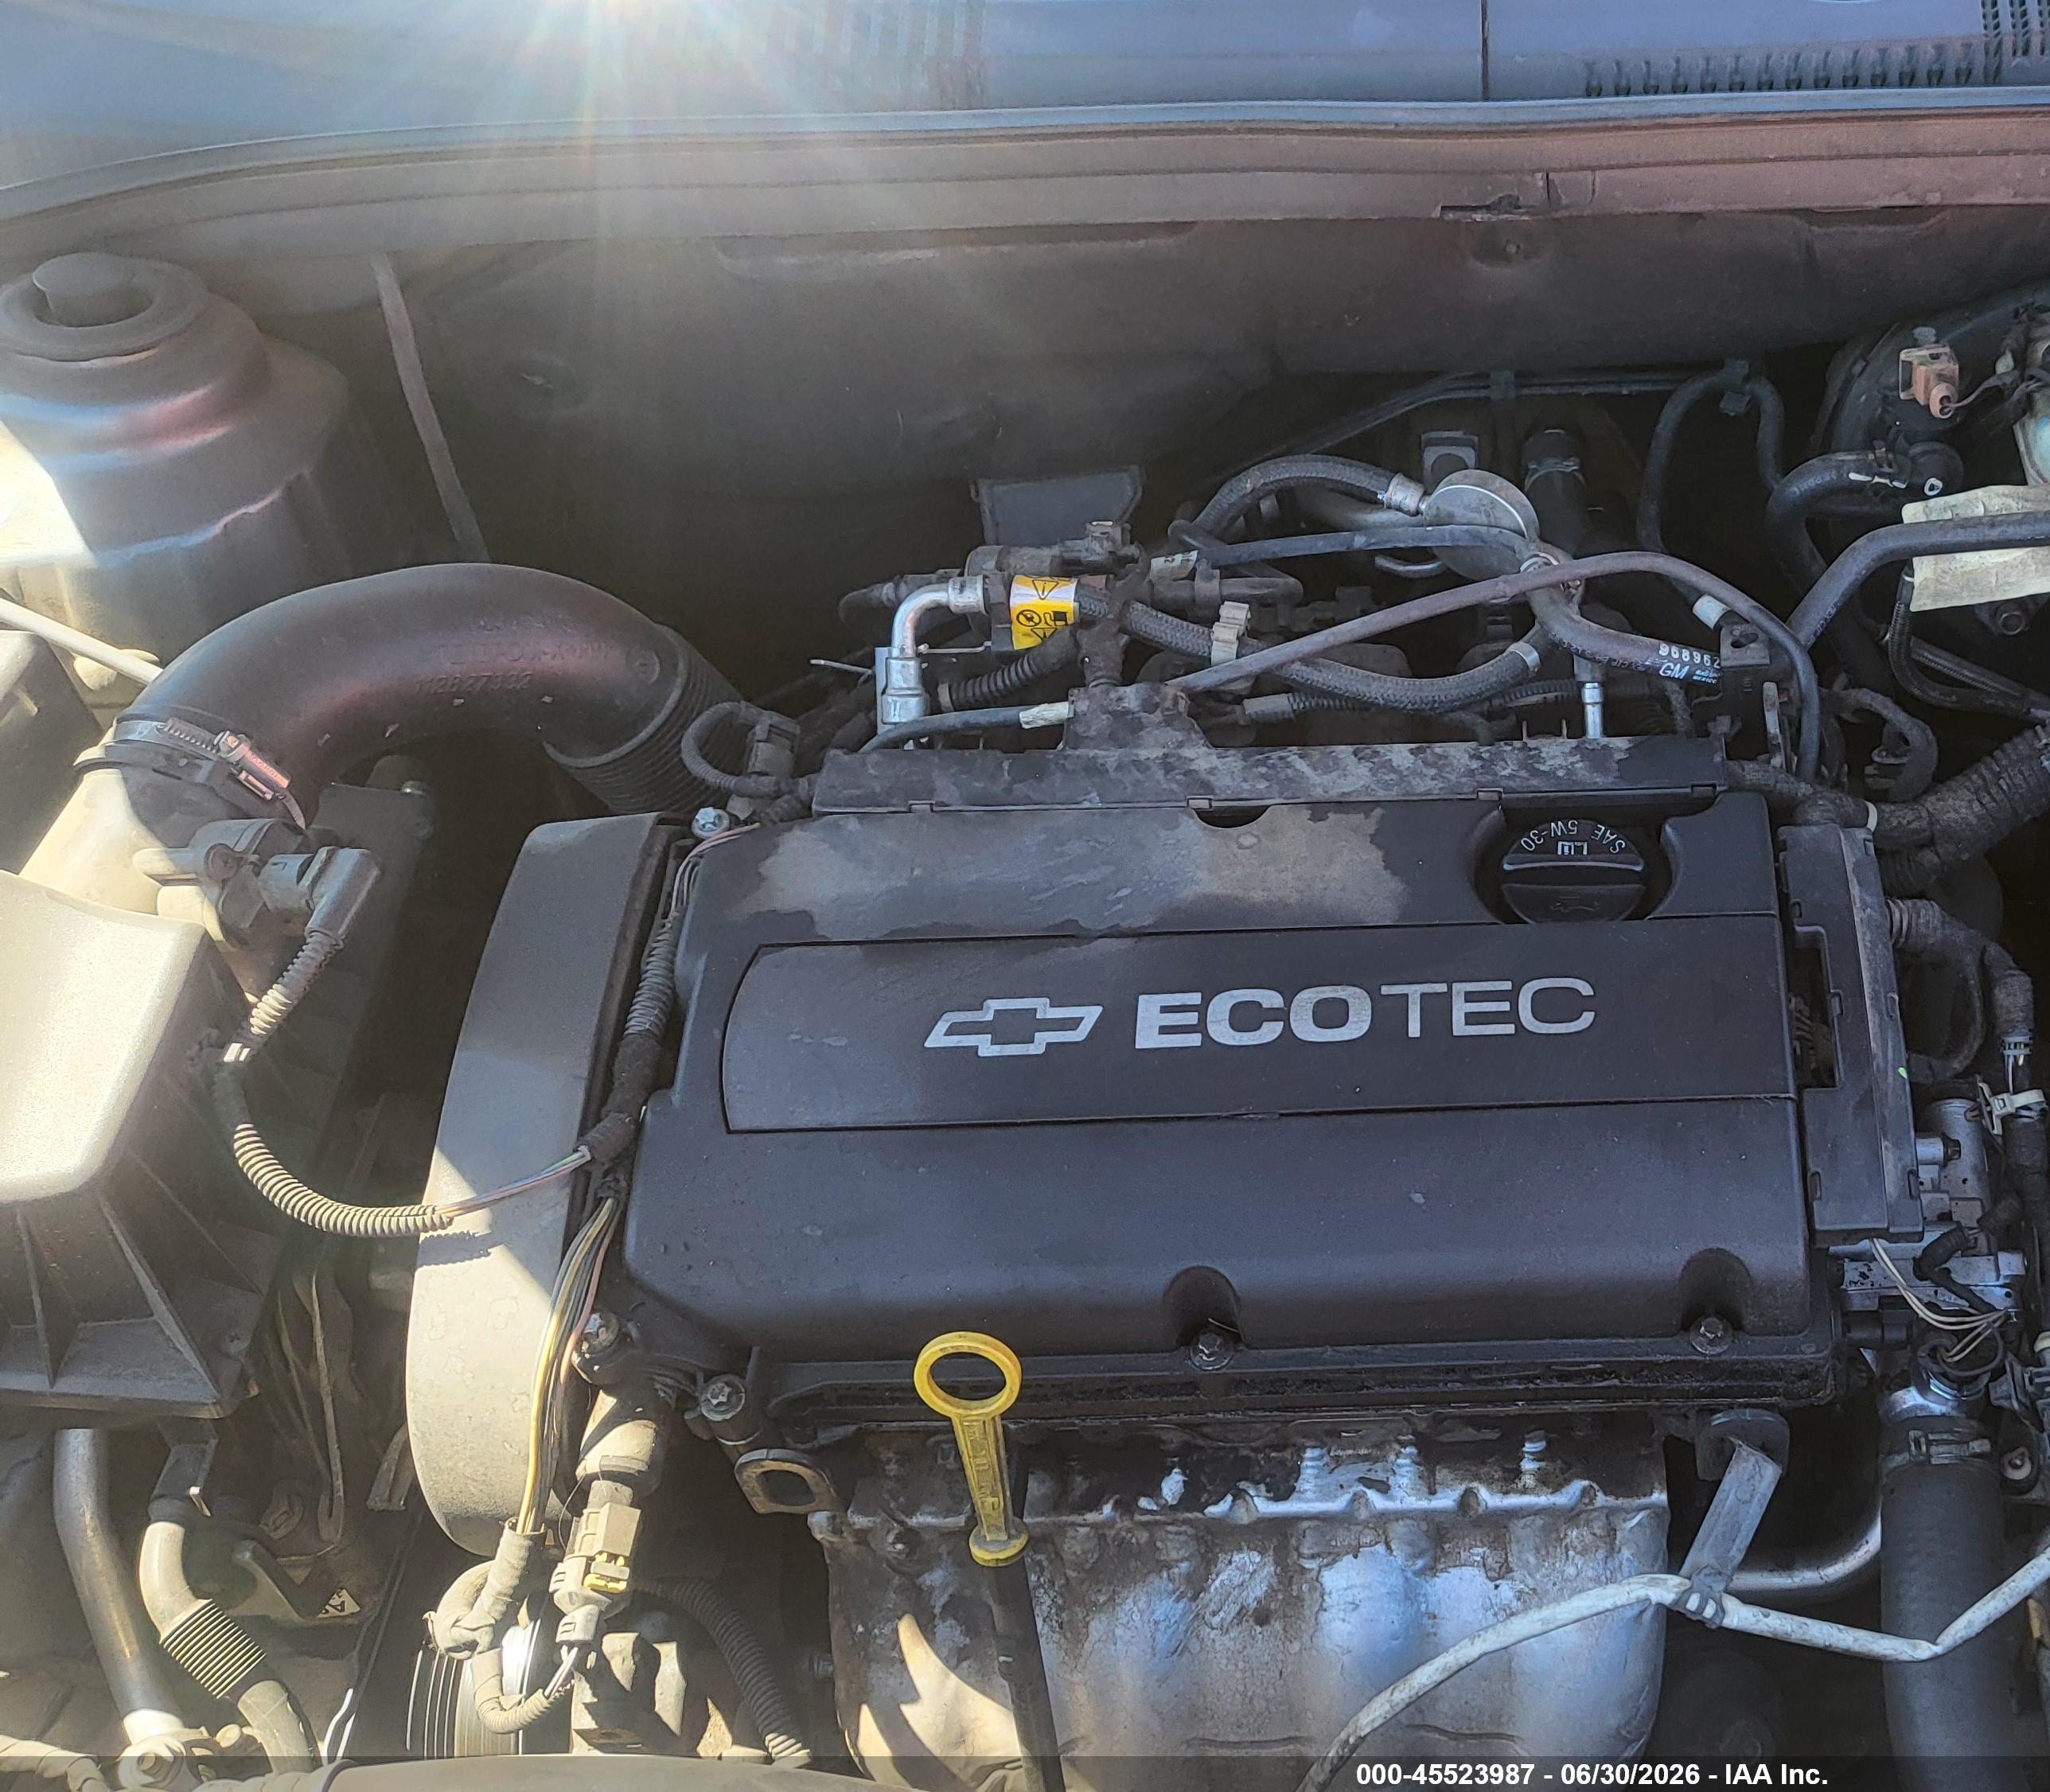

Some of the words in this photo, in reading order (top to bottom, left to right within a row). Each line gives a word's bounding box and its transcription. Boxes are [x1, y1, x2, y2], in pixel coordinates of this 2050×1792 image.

[1659, 662, 1689, 679] GM
[1521, 820, 1578, 851] 5W-30
[1591, 824, 1626, 854] SAE
[1135, 977, 1596, 1049] ECOTEC
